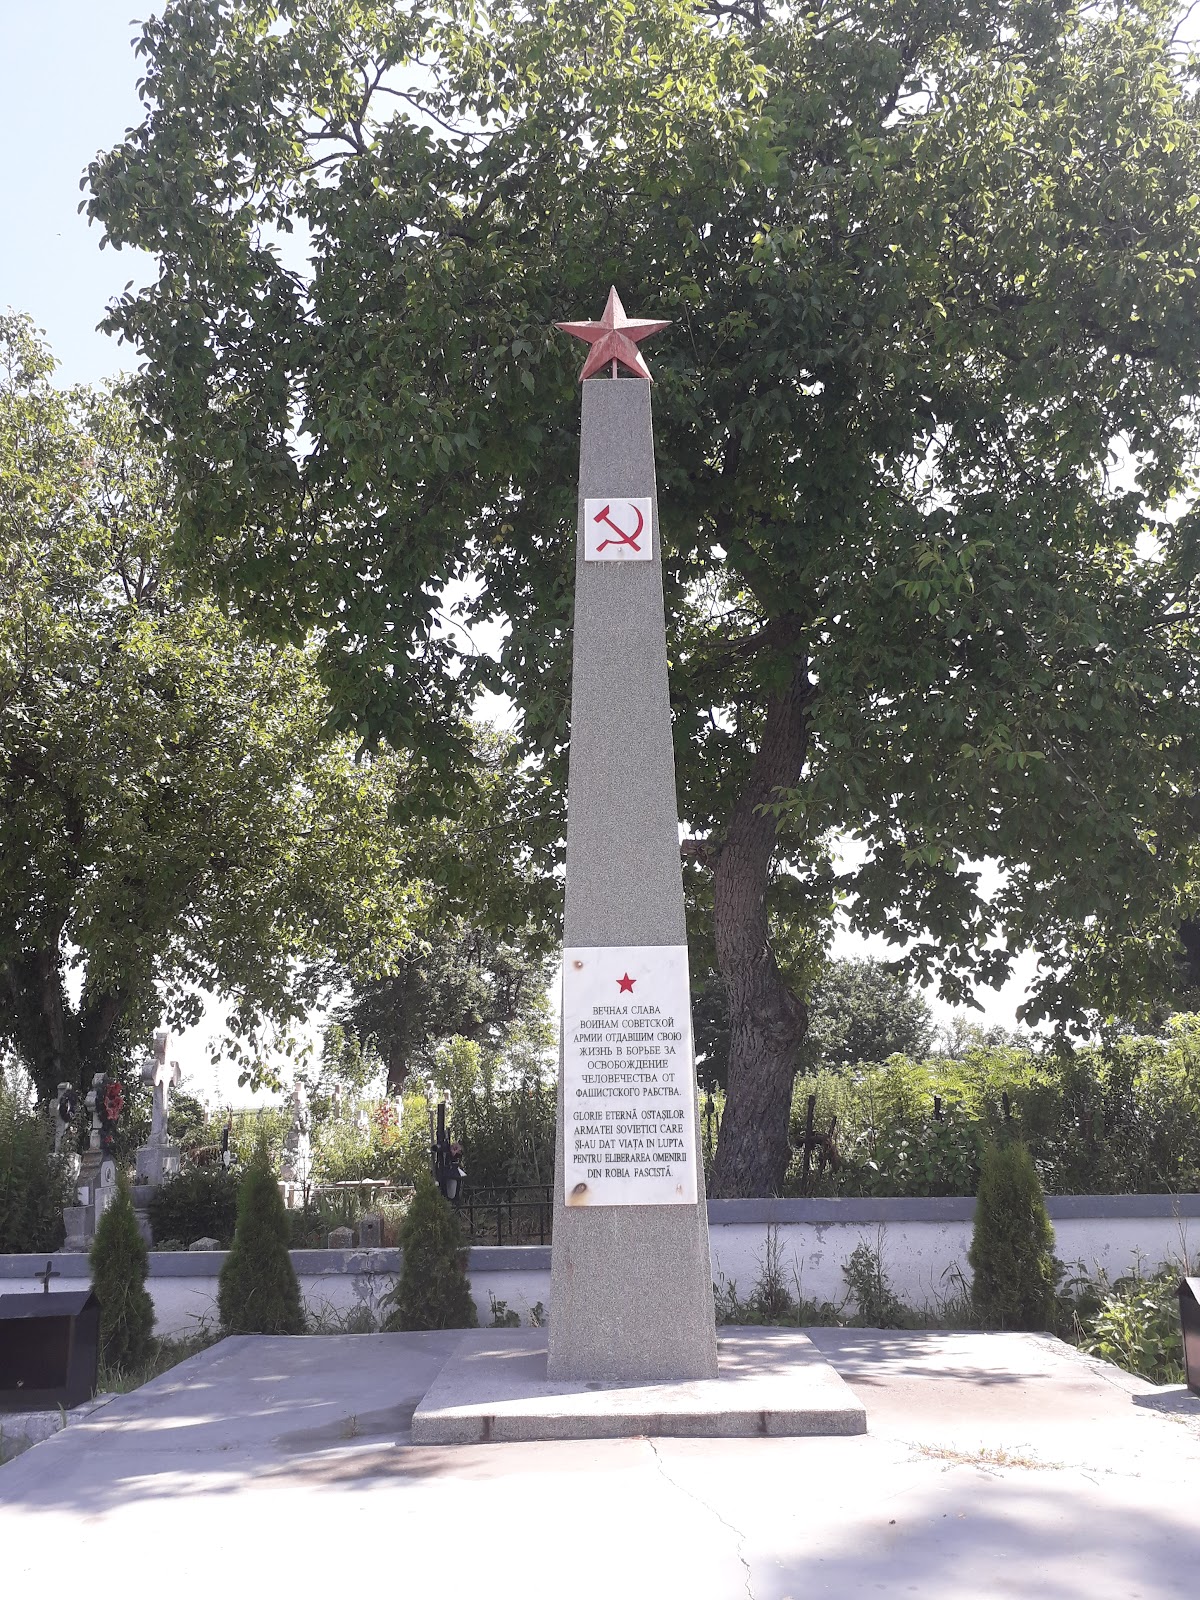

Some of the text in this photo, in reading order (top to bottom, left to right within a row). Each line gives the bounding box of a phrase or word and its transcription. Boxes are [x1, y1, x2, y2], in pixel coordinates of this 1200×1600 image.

[593, 1006, 660, 1015] ВЕЧНАЯ СЛАВА
[580, 1017, 674, 1028] ВОИНАМ СОВЕТСКОЙ
[574, 1032, 682, 1043] АРМИИ ОТДАВШИМ СВОЮ
[580, 1046, 676, 1056] ЖИЗНЬ В БОРЬБЕ ЗА
[587, 1060, 668, 1070] ОСВОБОЖДЕНИЕ
[582, 1073, 675, 1083] ЧЕЛОВЕЧЕСТВА ОТ
[576, 1087, 681, 1097] ФАШИСТСКОГО РАБСТВА.
[573, 1111, 602, 1120] GLORIE
[606, 1109, 638, 1120] ETERNĂ
[574, 1124, 683, 1135] ARMATEI SOVIETICI CARE
[599, 1139, 615, 1148] DAT
[646, 1139, 655, 1147] IN
[658, 1139, 684, 1147] LUPTA
[573, 1153, 686, 1163] PENTRU ELIBERAREA OMENIRII
[587, 1165, 673, 1178] DIN ROBIA FASCISTĂ.
